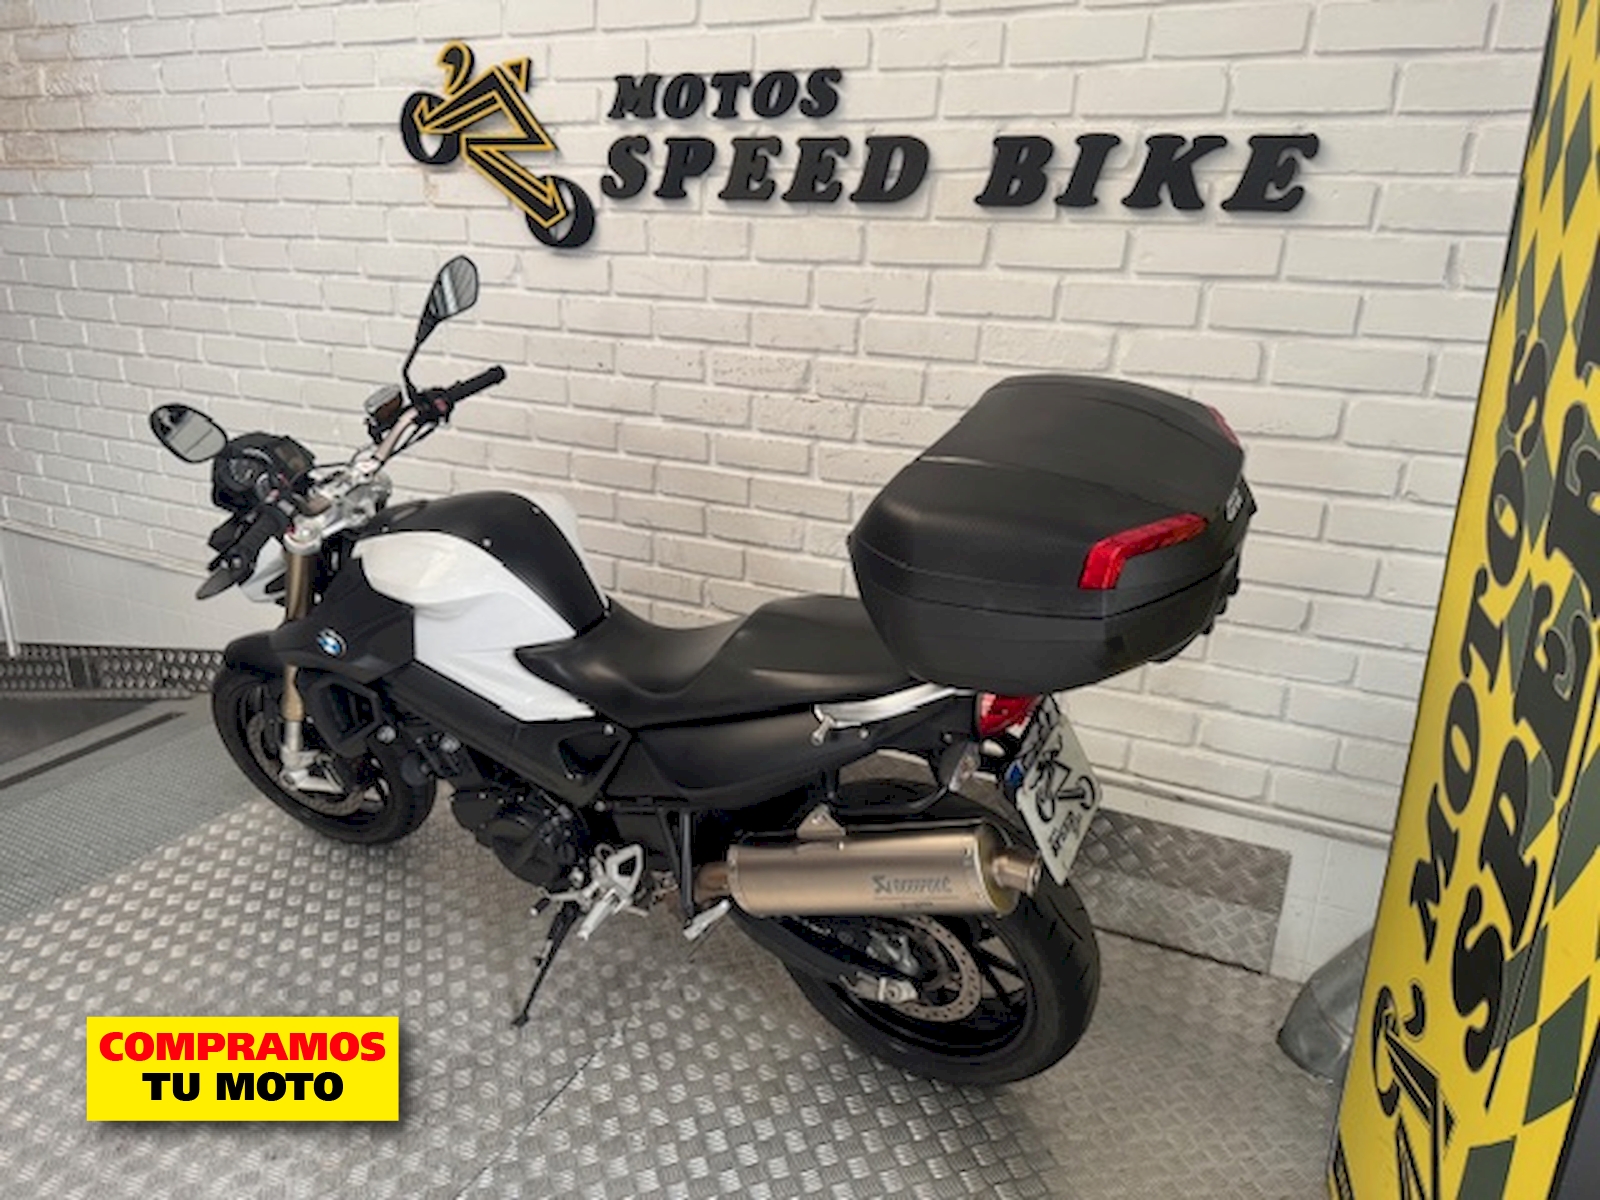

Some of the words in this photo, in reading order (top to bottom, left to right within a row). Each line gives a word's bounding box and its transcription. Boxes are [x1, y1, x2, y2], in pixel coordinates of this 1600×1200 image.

[607, 67, 843, 120] MOTOS
[600, 134, 930, 204] SPEED
[973, 133, 1320, 212] BIKE
[1409, 335, 1548, 963] MOTOS
